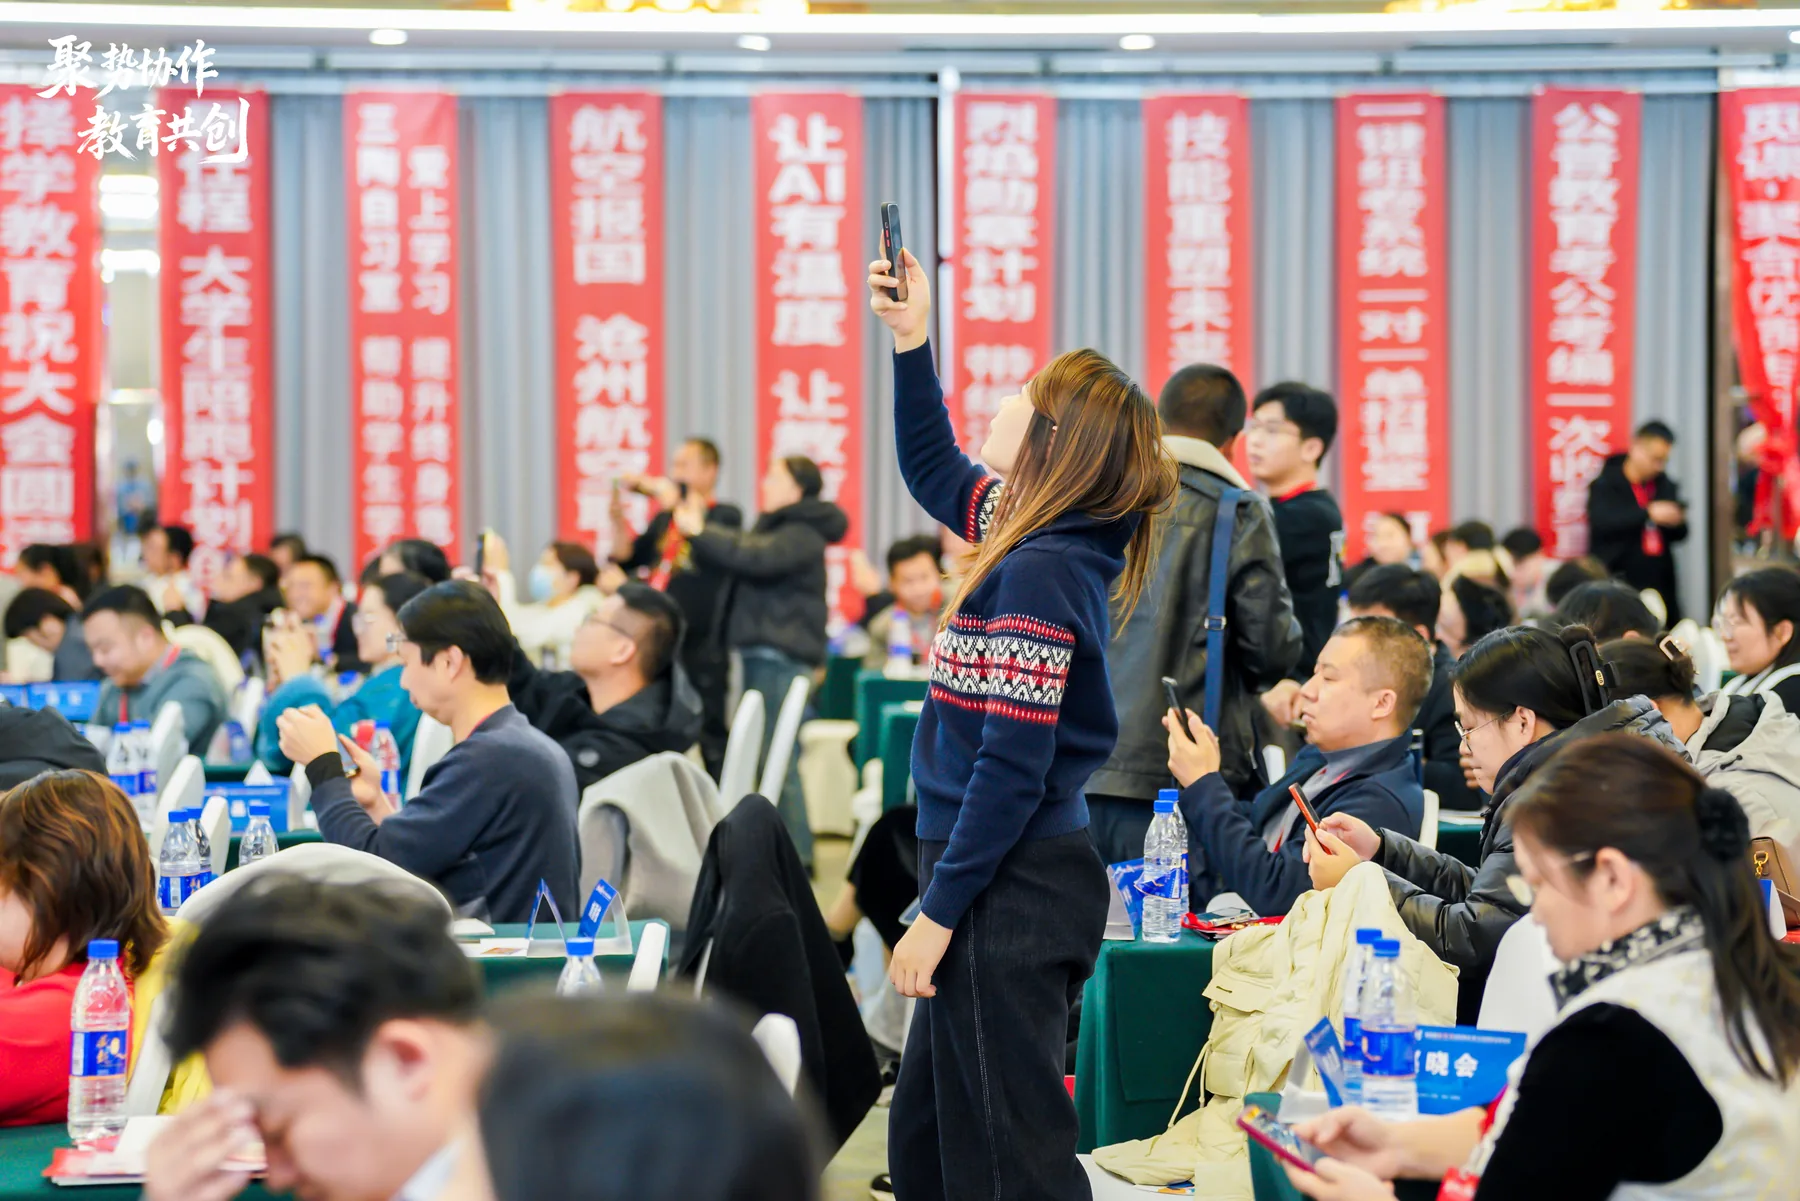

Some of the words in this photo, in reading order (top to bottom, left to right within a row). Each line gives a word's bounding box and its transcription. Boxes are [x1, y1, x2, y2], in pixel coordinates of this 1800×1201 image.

[569, 104, 648, 285] 航空报国
[768, 112, 847, 347] 让AI有温度
[1165, 111, 1233, 372] 技能重塑未来
[573, 313, 652, 568] 沧州航空职
[1414, 1050, 1479, 1078] 晓会
